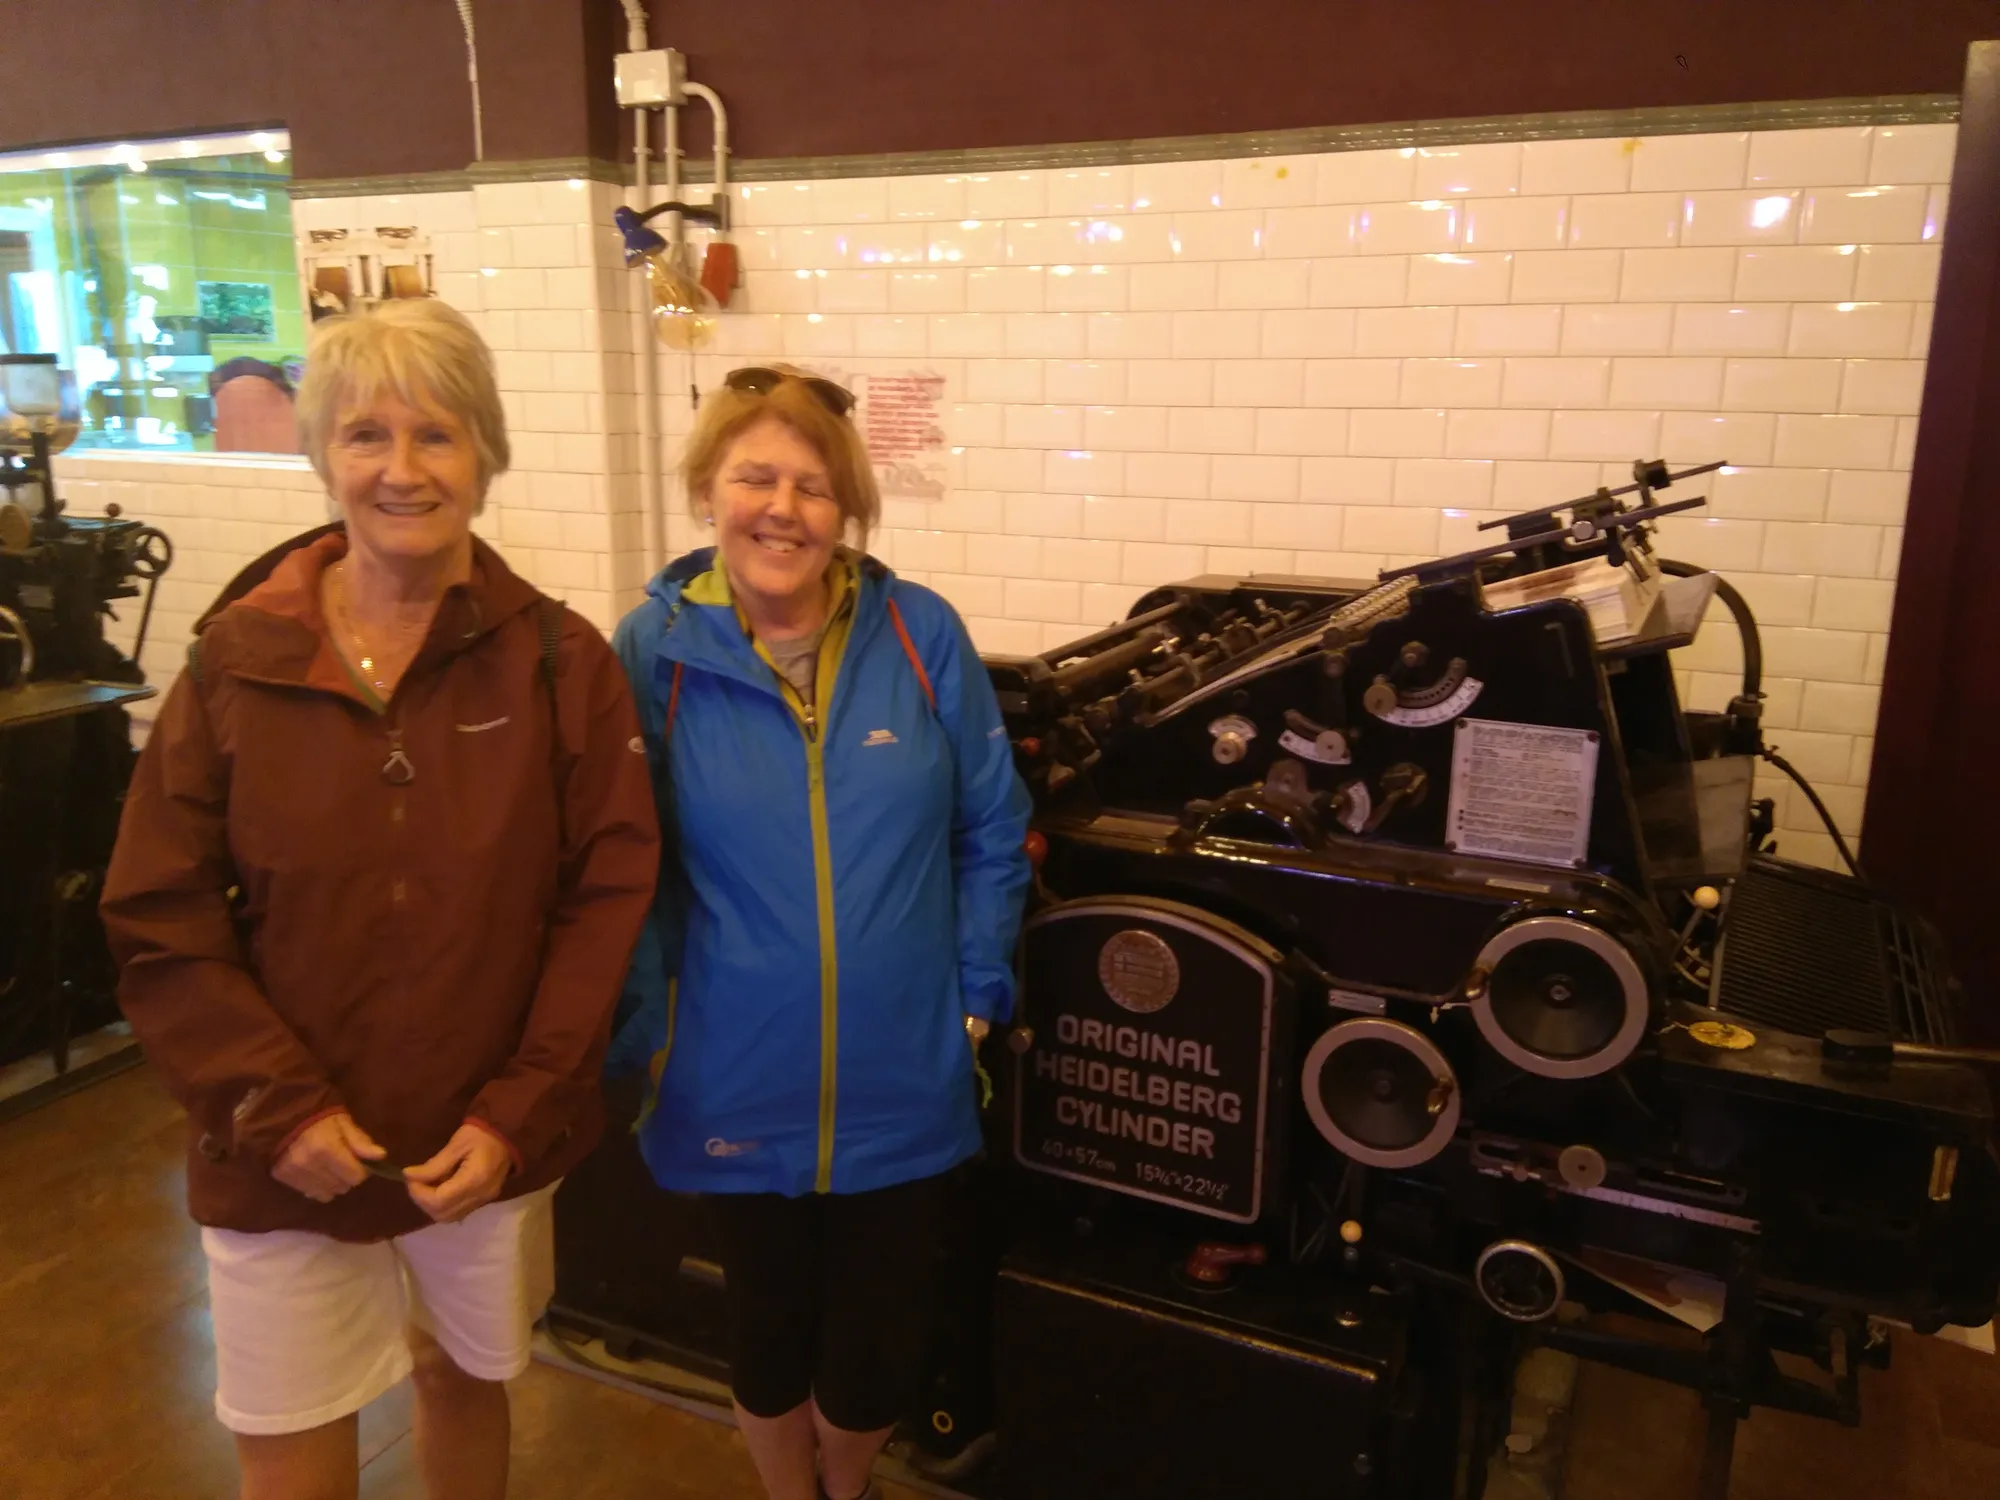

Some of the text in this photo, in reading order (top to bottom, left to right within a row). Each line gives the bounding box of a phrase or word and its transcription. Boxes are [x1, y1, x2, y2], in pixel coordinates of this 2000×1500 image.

[1057, 1014, 1220, 1076] ORIGINAL
[1035, 1049, 1241, 1124] HEIDELBERG
[1056, 1096, 1215, 1160] CYLINDER
